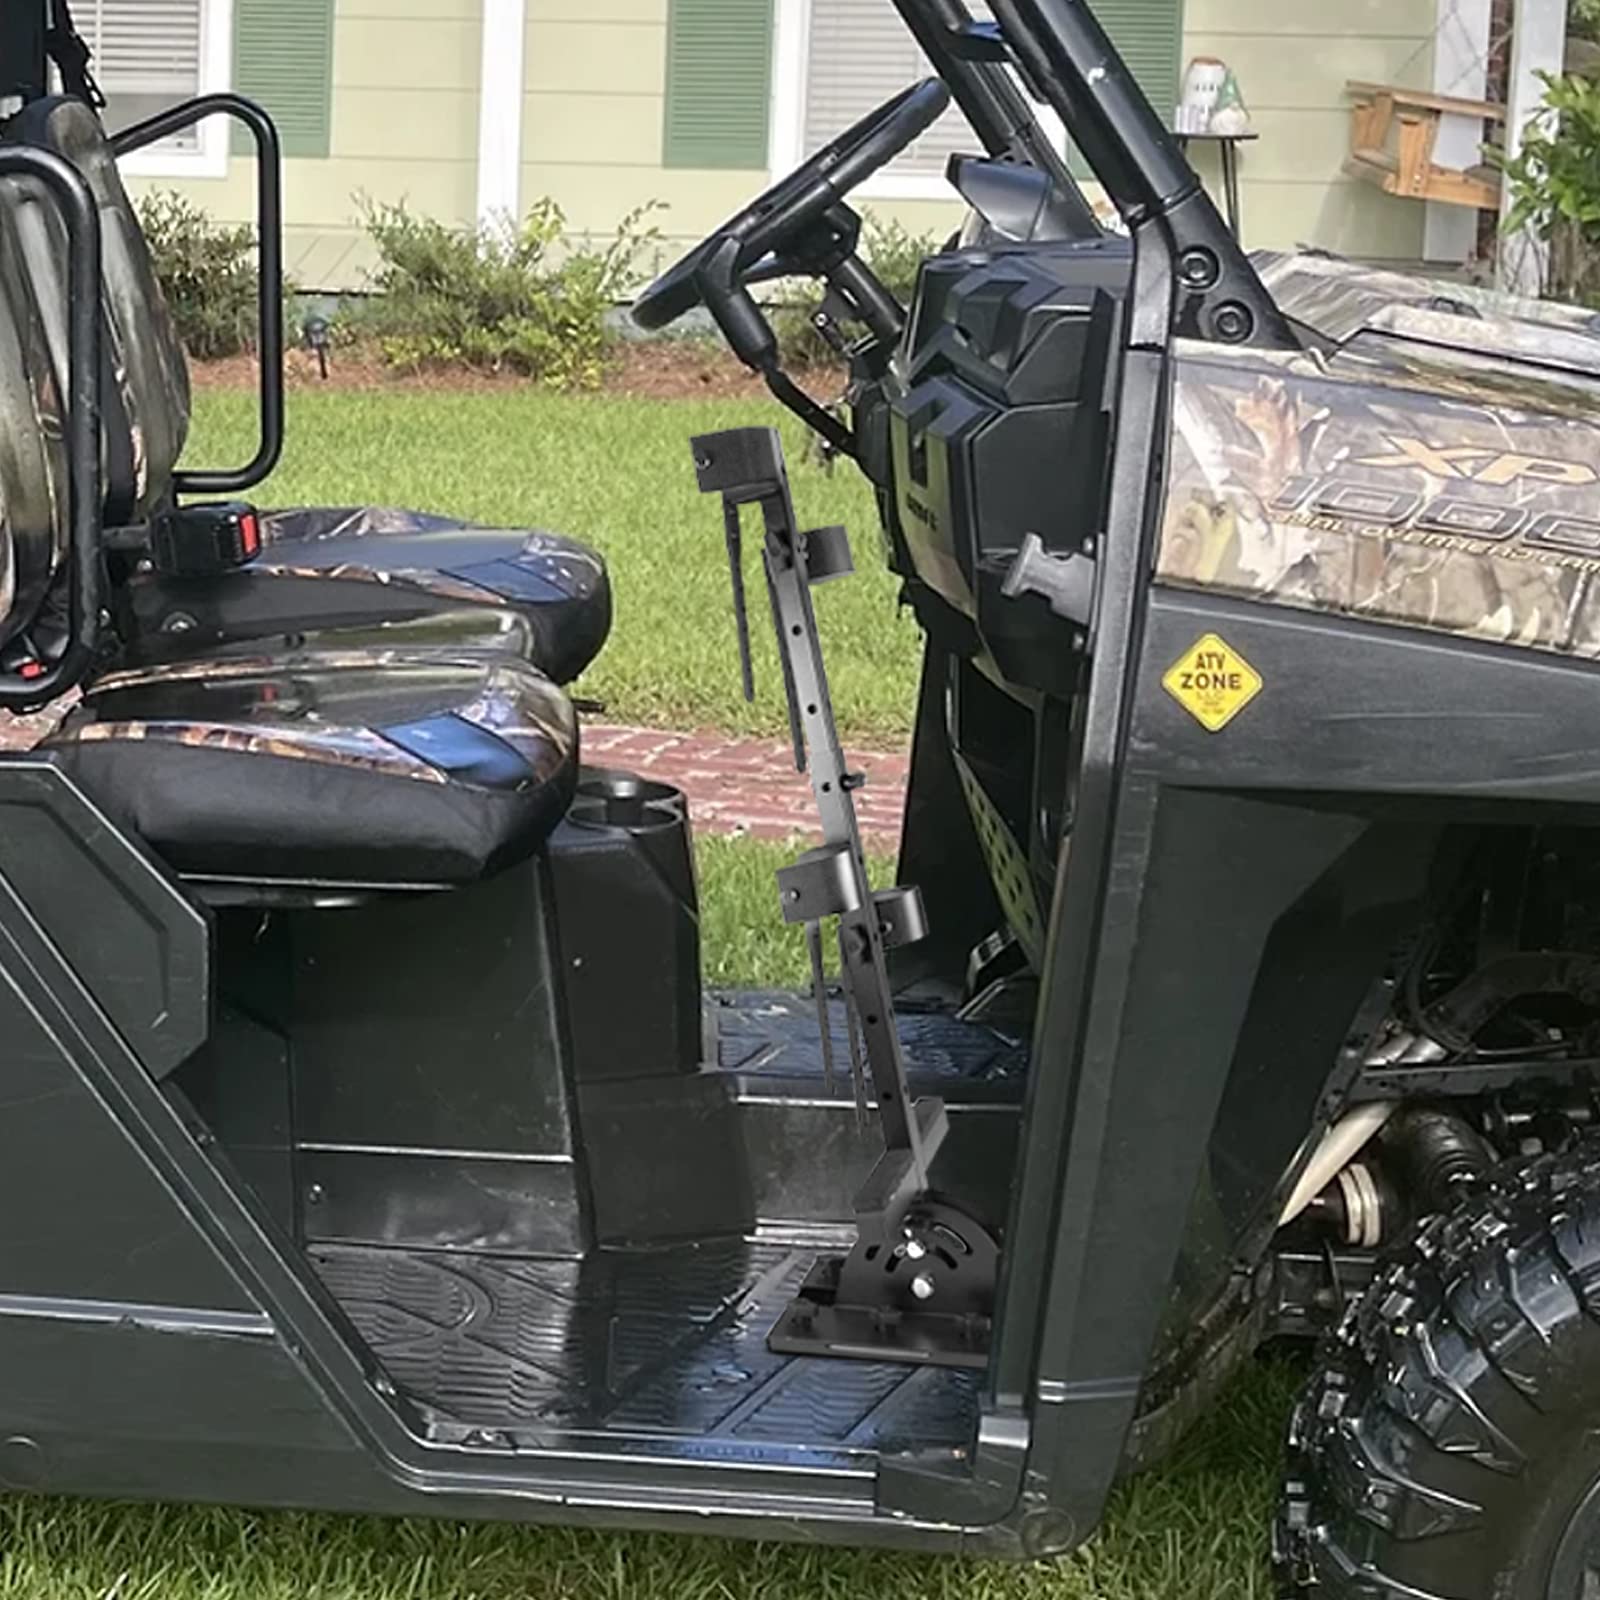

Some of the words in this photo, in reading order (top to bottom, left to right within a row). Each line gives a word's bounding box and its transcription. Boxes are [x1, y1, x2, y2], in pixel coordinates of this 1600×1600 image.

[1352, 432, 1599, 486] XP
[1195, 652, 1226, 670] ATV
[1180, 672, 1242, 690] ZONE
